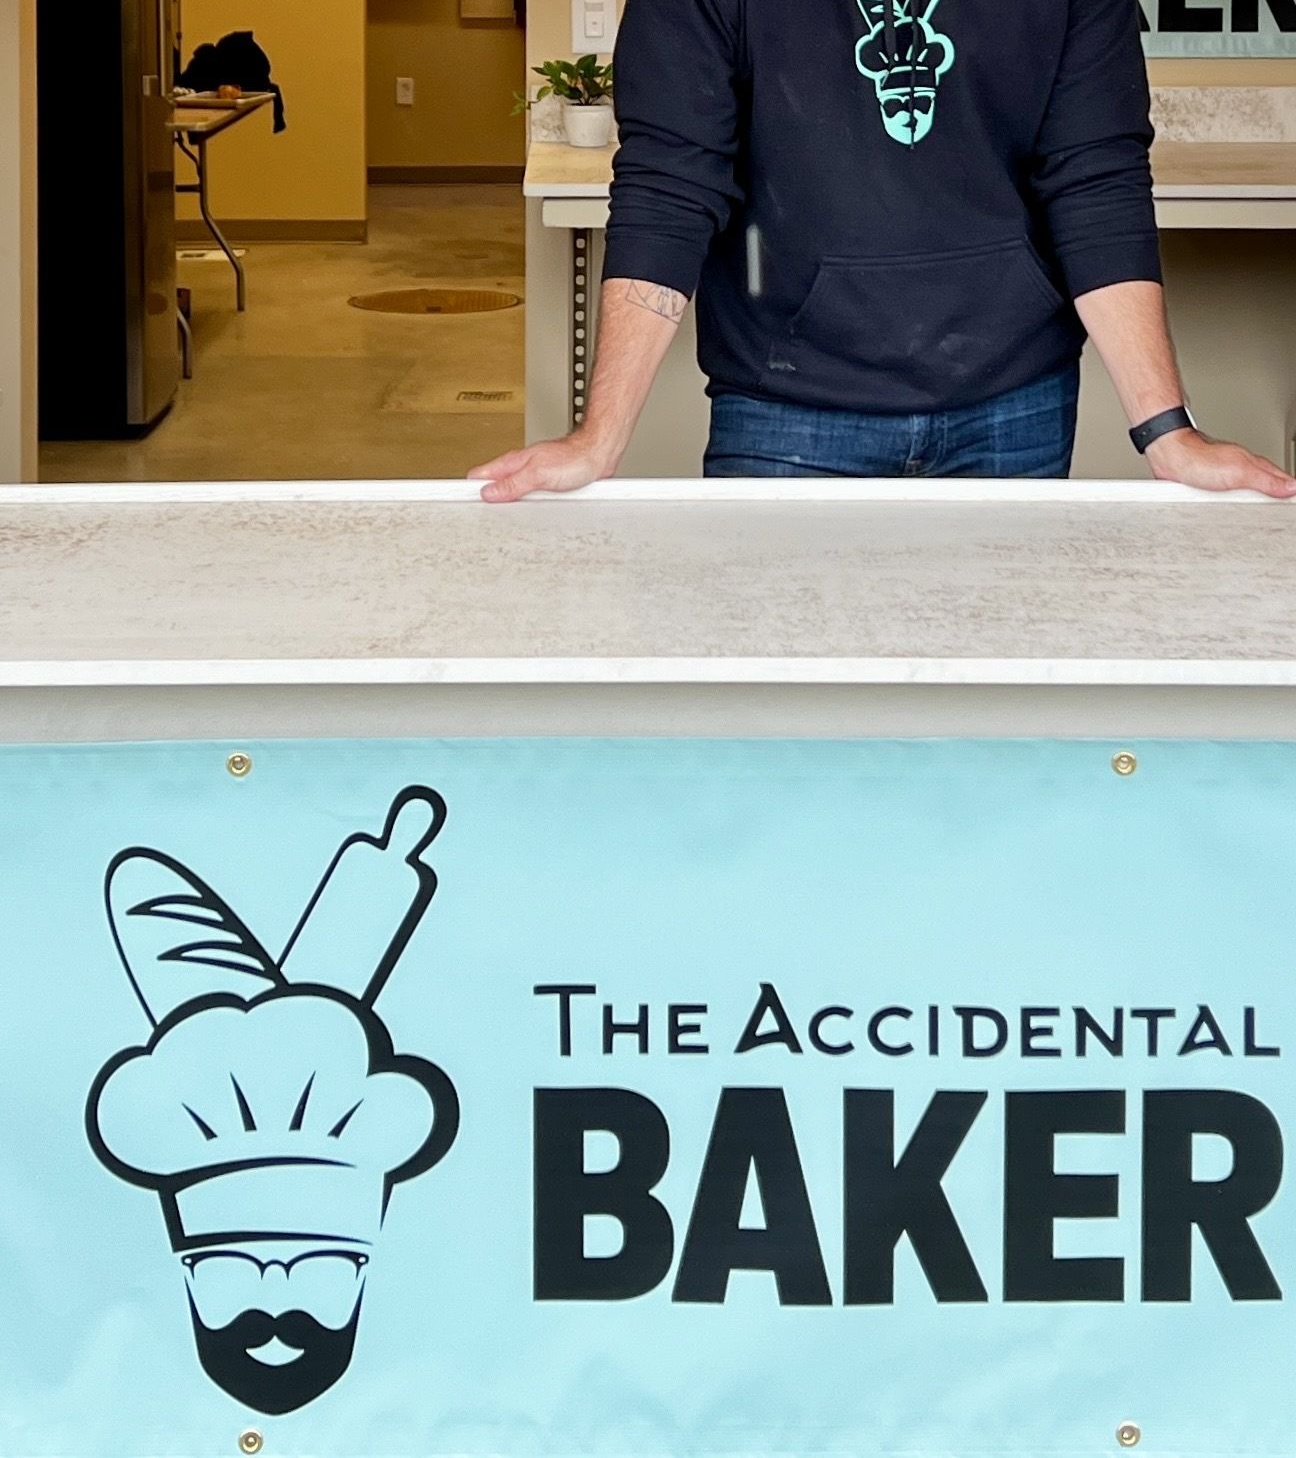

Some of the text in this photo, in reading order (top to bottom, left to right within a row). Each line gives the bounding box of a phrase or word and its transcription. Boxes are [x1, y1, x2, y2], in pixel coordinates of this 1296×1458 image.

[532, 983, 1281, 1058] THE ACCIDENTAL
[532, 1086, 1284, 1307] BAKER
